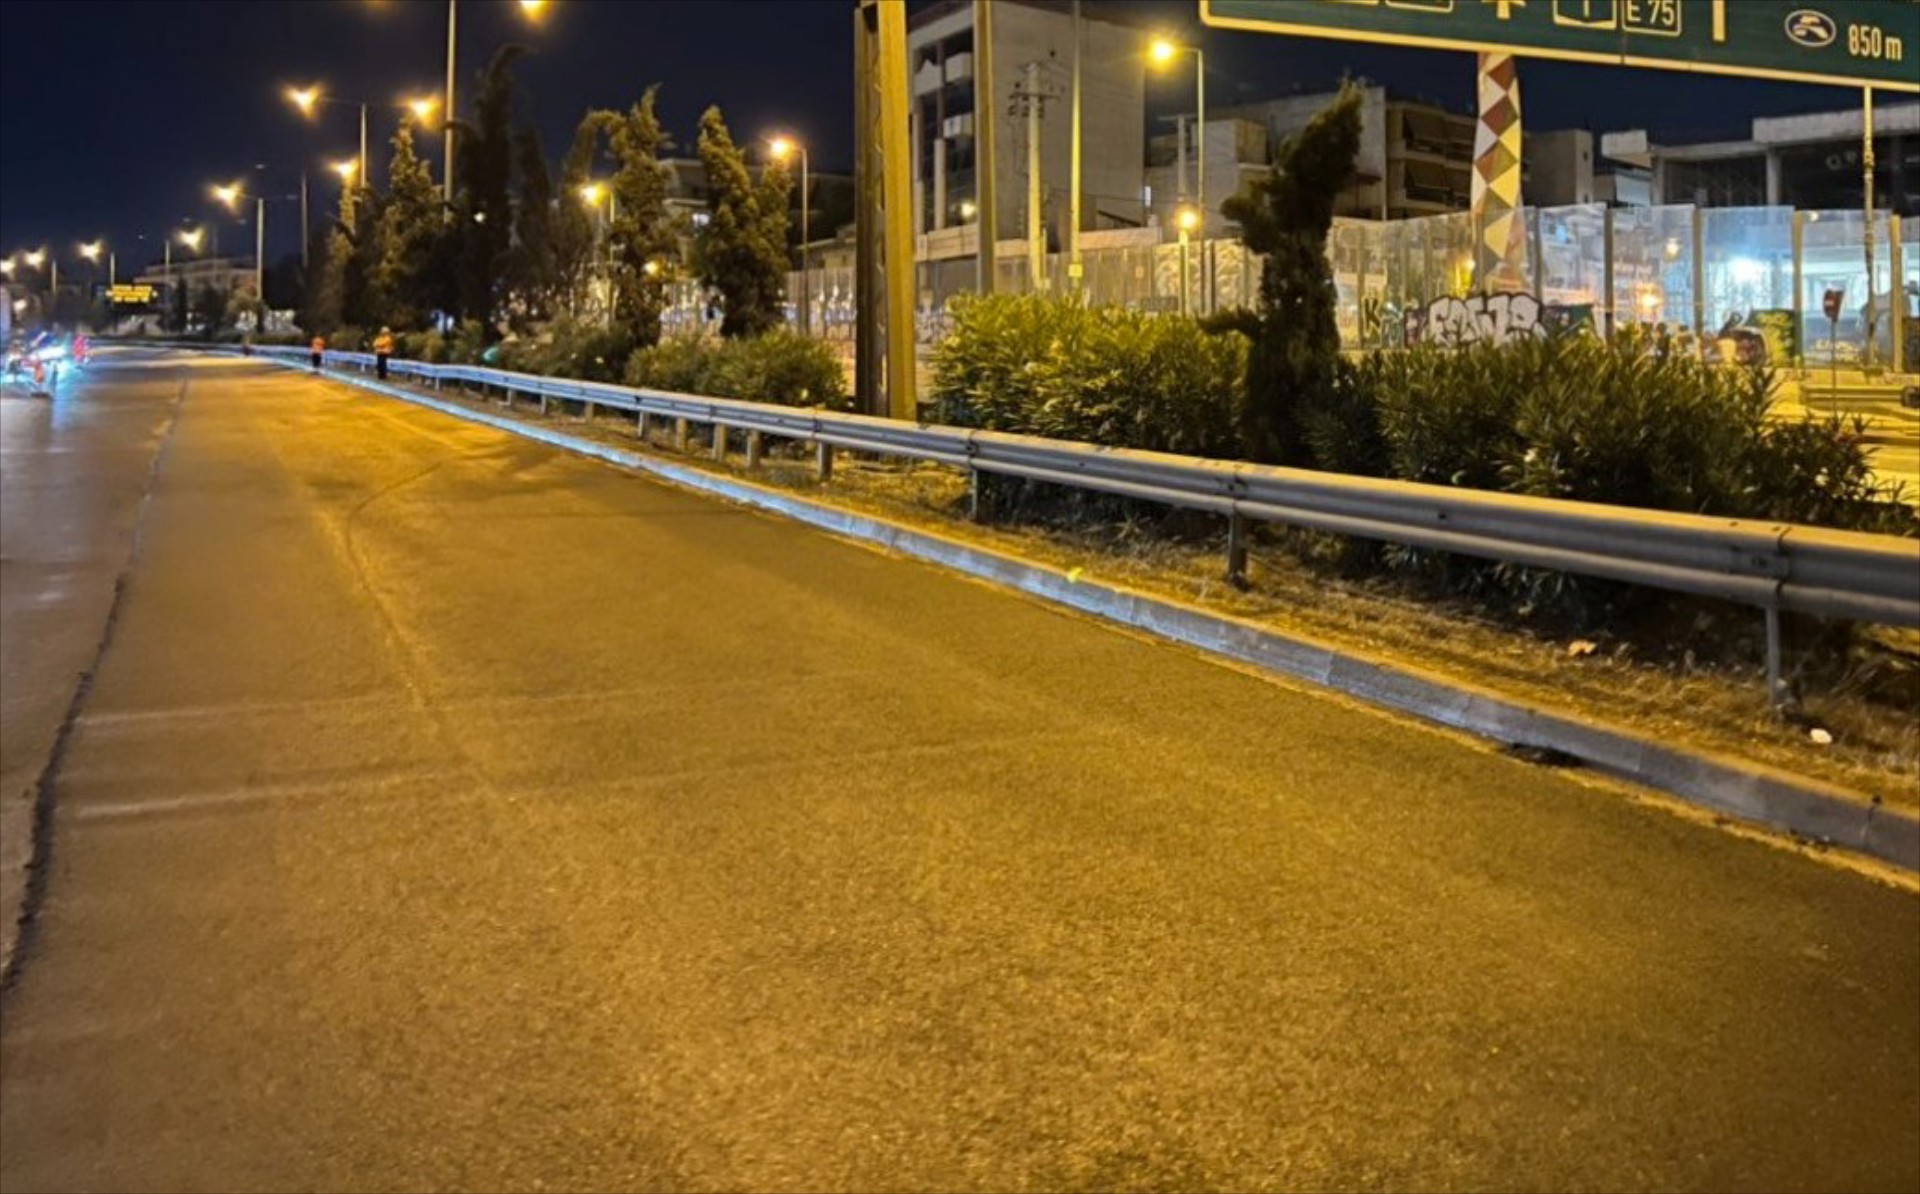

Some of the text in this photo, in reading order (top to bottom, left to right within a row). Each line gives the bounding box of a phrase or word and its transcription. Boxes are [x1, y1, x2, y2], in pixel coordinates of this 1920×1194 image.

[1626, 0, 1675, 26] E 75
[1848, 23, 1902, 61] 850 m
